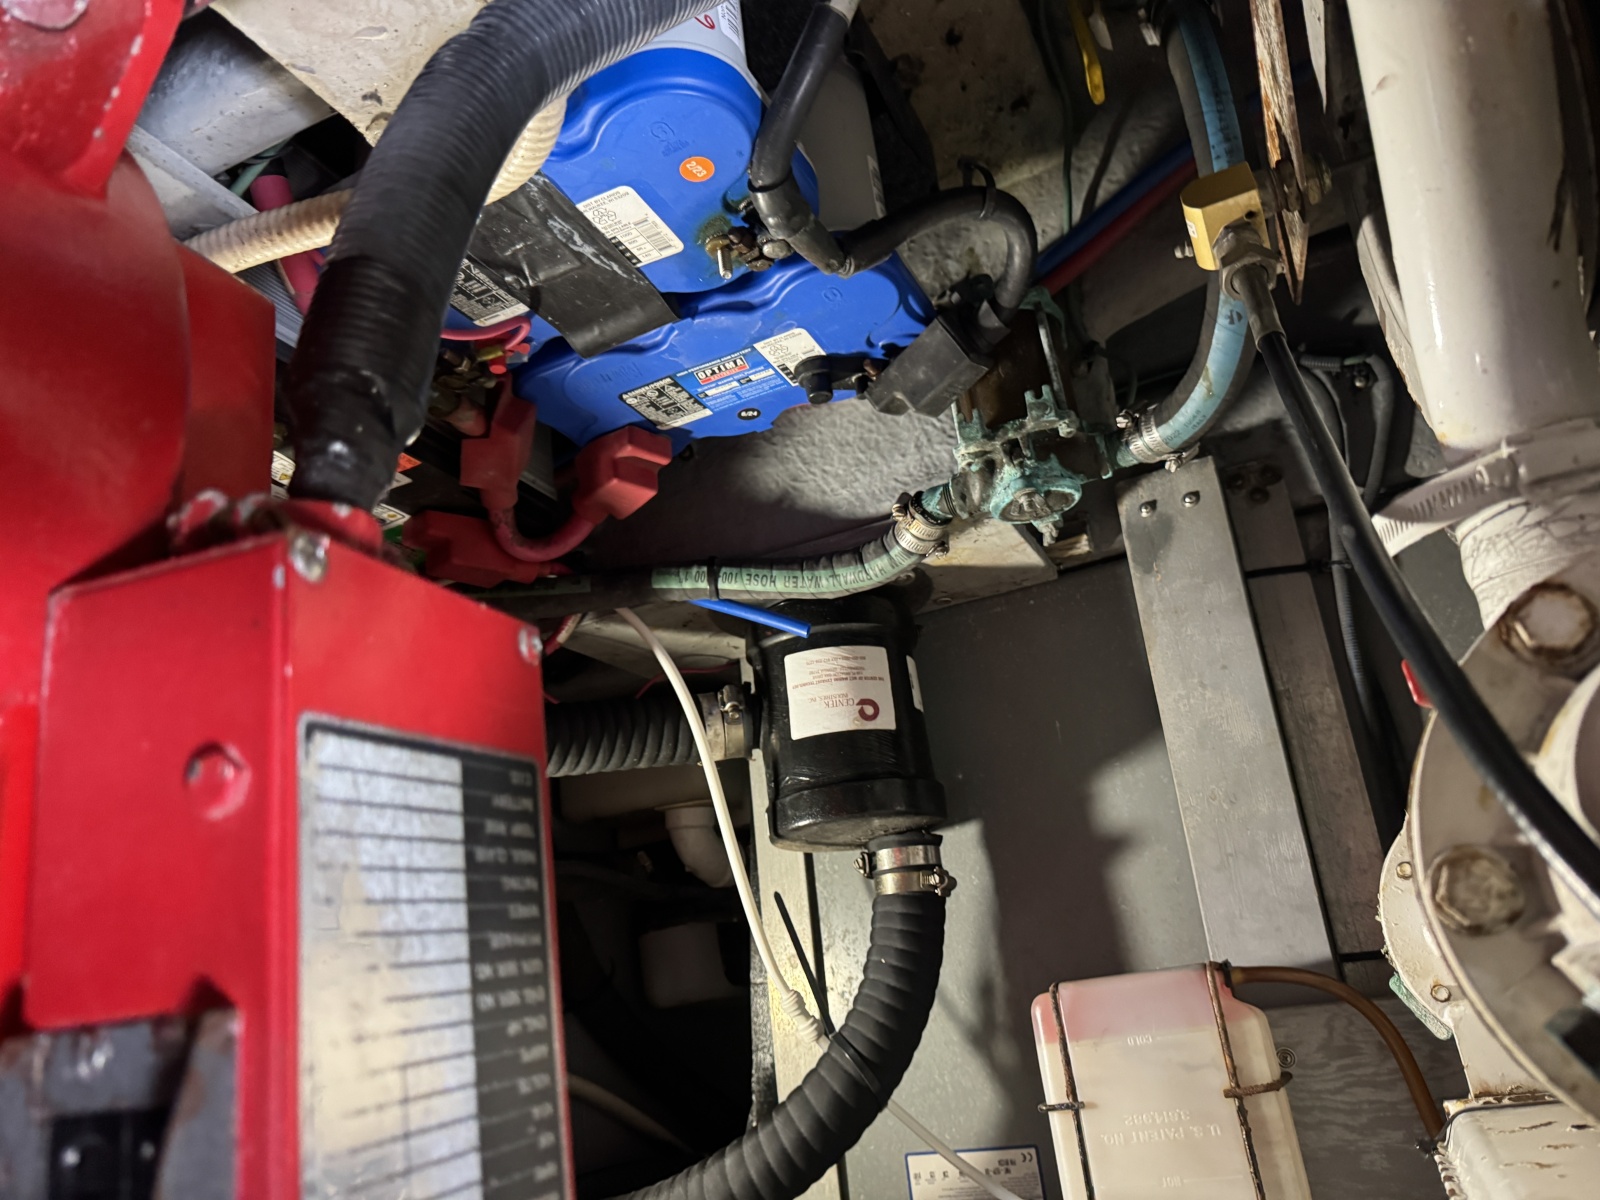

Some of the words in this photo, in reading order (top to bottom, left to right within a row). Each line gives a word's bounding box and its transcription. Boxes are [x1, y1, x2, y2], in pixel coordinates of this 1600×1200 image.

[686, 161, 706, 177] 2/23
[698, 357, 744, 379] OPTIMA
[741, 410, 758, 418] 6/24
[745, 572, 776, 587] HOSE
[829, 563, 885, 585] HARDWALL
[783, 574, 823, 590] WATER
[824, 697, 855, 708] CENTEK
[1127, 1034, 1153, 1046] COLD
[1130, 1126, 1183, 1144] PATENT
[1207, 1124, 1220, 1136] U.
[1100, 1132, 1124, 1145] NO.
[1161, 1176, 1182, 1187] HOT
